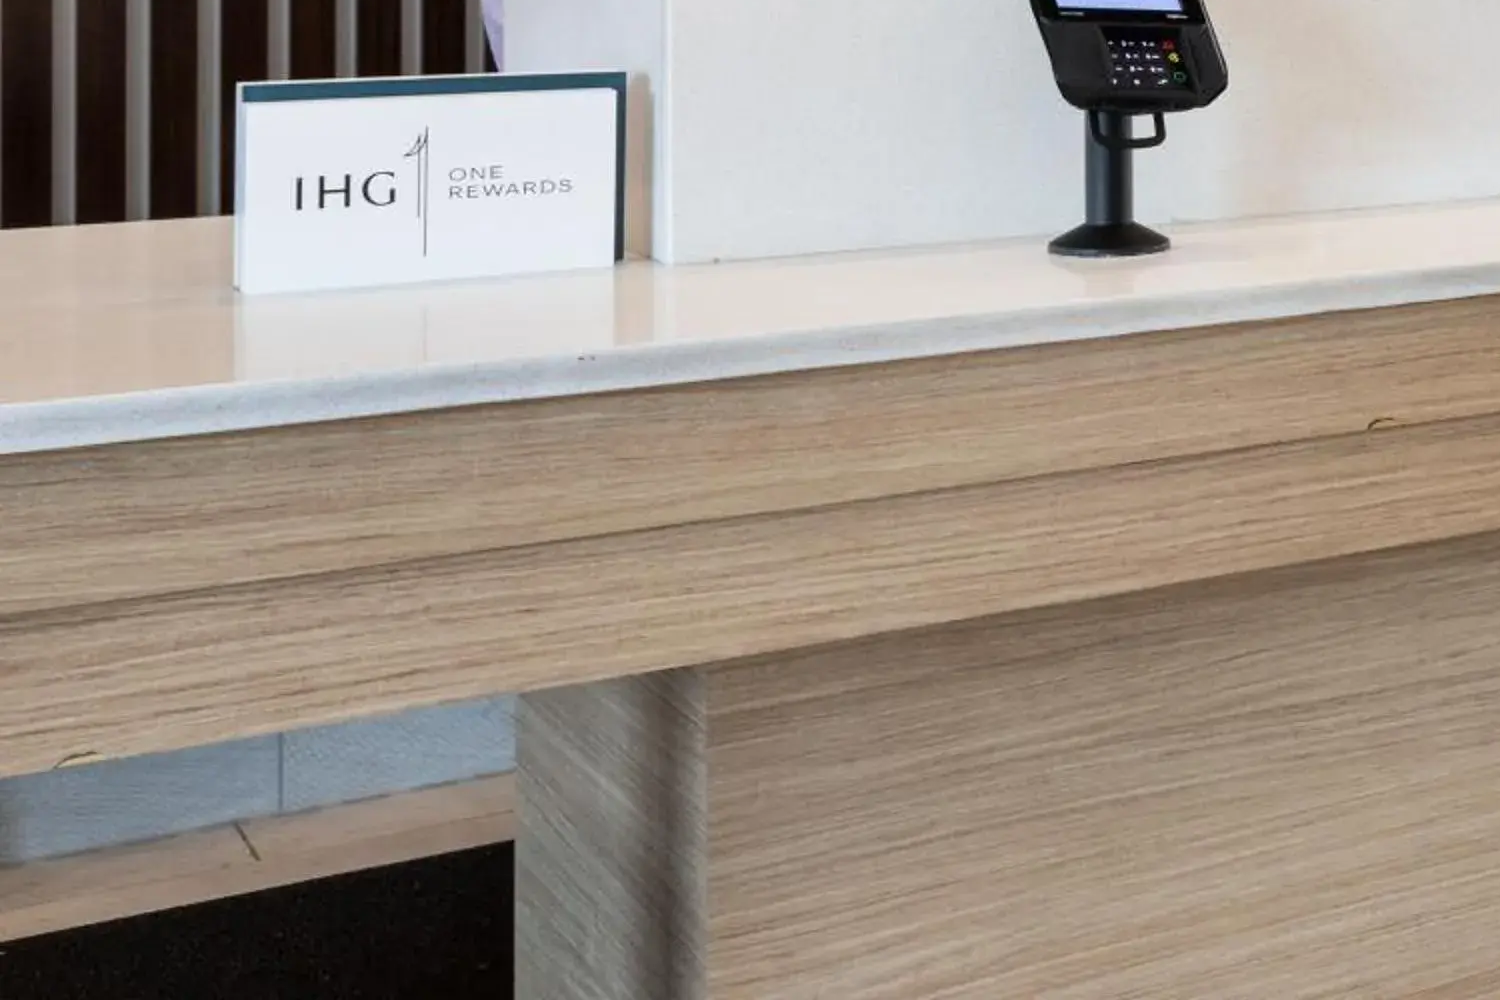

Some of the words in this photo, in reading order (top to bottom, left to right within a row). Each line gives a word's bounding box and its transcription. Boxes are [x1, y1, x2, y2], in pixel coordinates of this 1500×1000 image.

[447, 164, 504, 183] ONE
[295, 170, 397, 211] IHG
[447, 178, 575, 200] REWARDS
